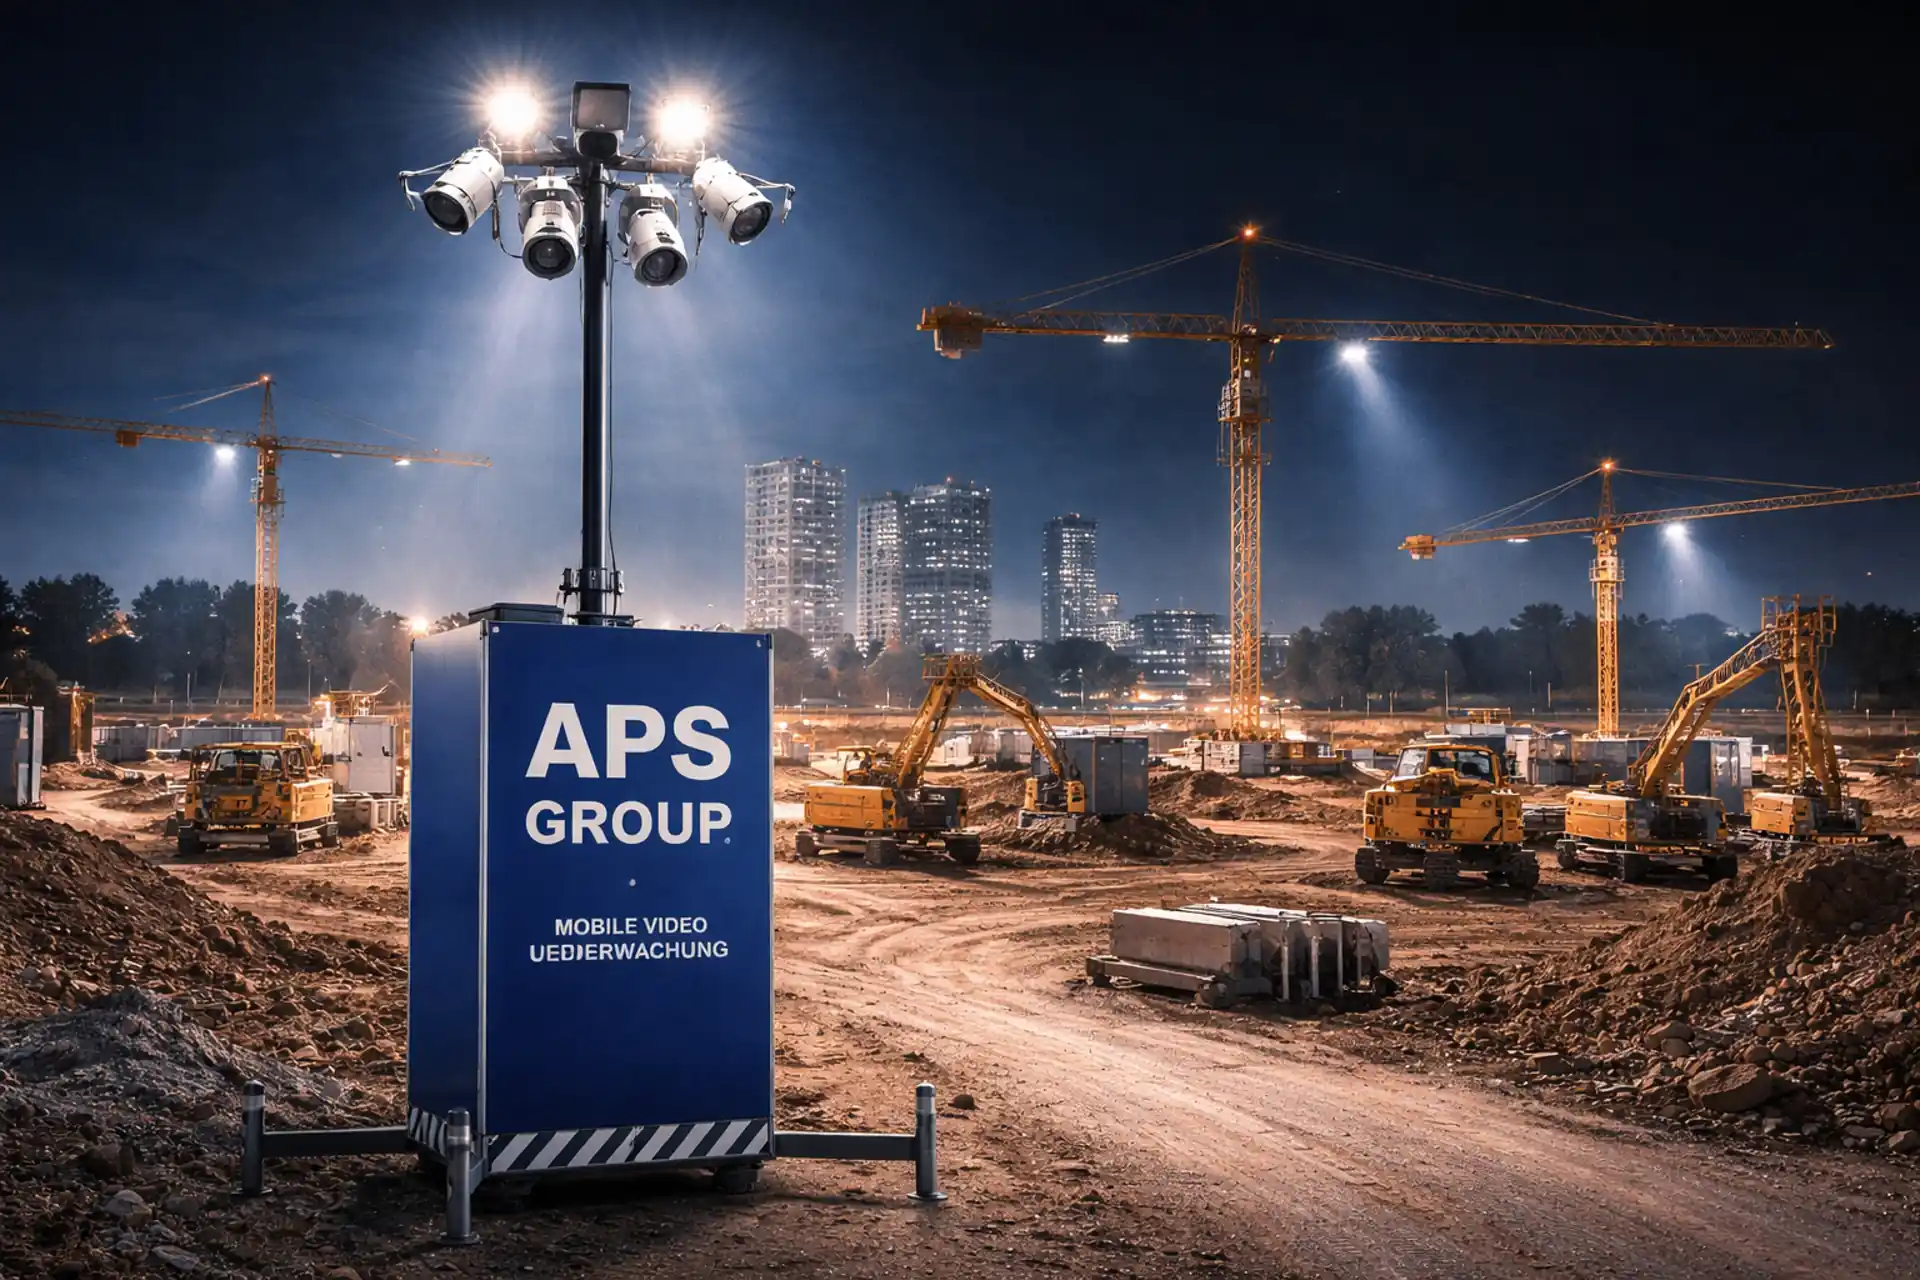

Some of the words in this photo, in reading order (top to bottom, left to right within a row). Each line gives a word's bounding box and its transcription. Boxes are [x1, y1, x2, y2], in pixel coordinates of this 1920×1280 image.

[525, 702, 732, 781] APS
[525, 799, 732, 845] GROUP
[555, 918, 638, 936] MOBILE
[643, 916, 708, 934] VIDEO
